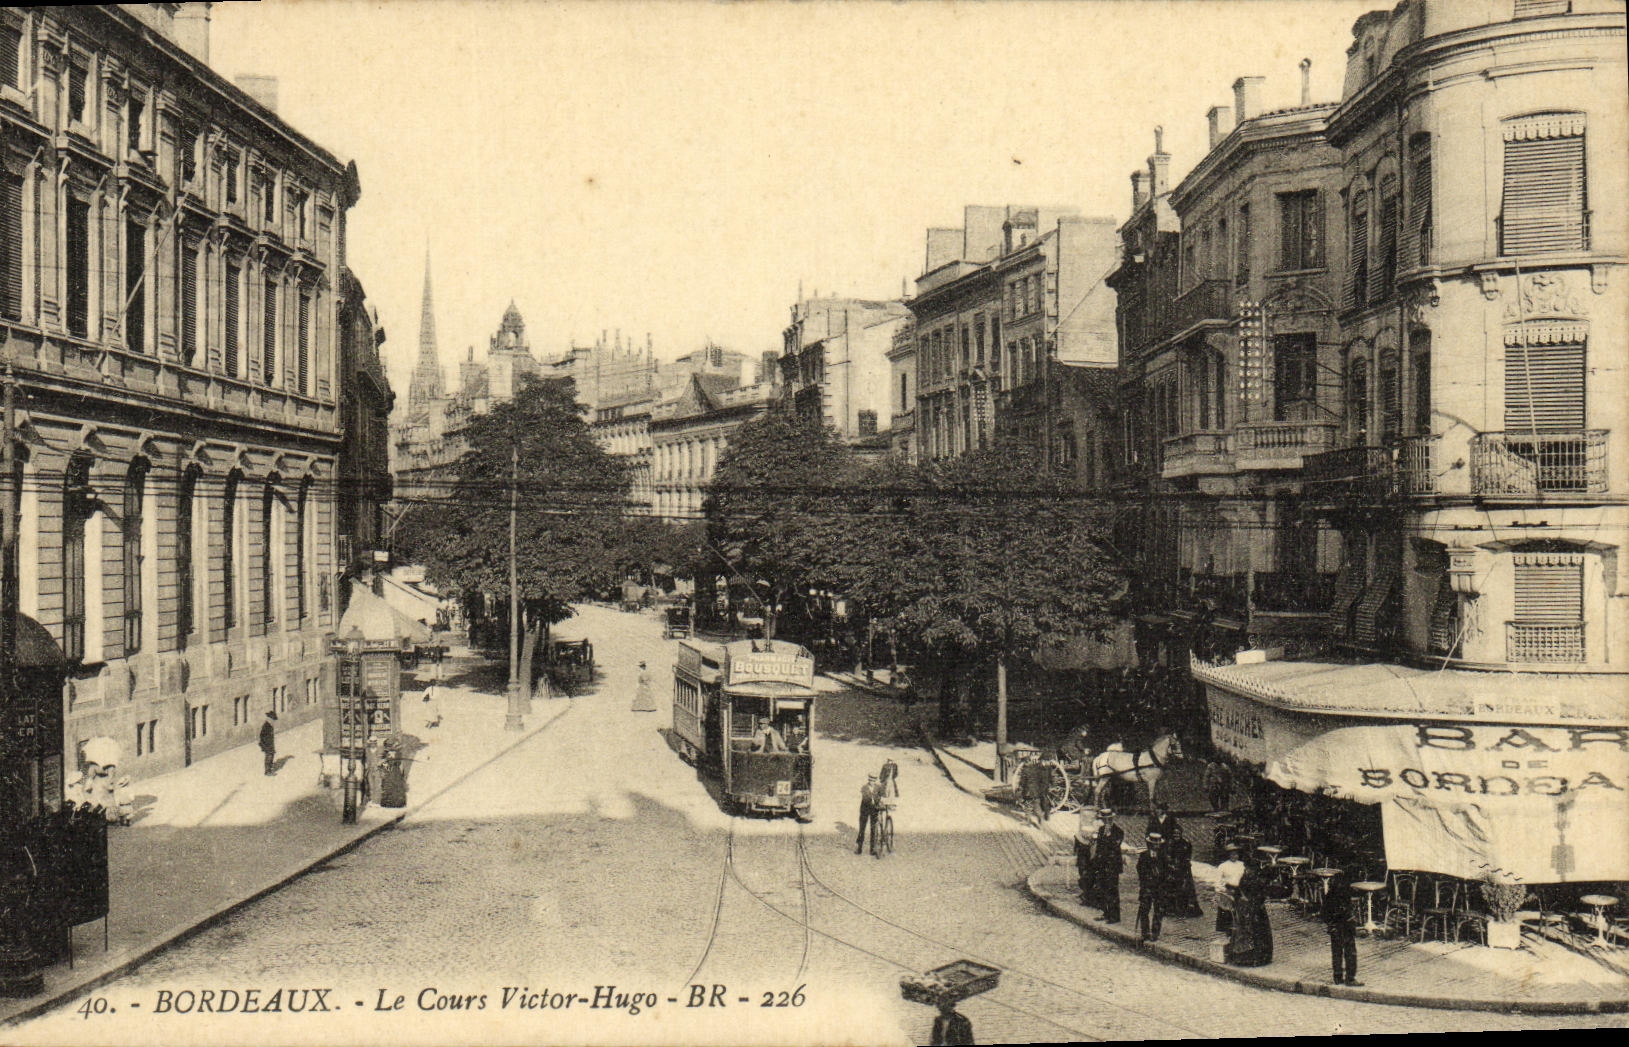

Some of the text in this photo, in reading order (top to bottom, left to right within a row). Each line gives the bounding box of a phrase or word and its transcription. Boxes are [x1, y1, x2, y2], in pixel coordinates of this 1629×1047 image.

[734, 661, 808, 675] BOUSQUET
[1416, 725, 1628, 752] BAR
[1502, 760, 1548, 769] DE
